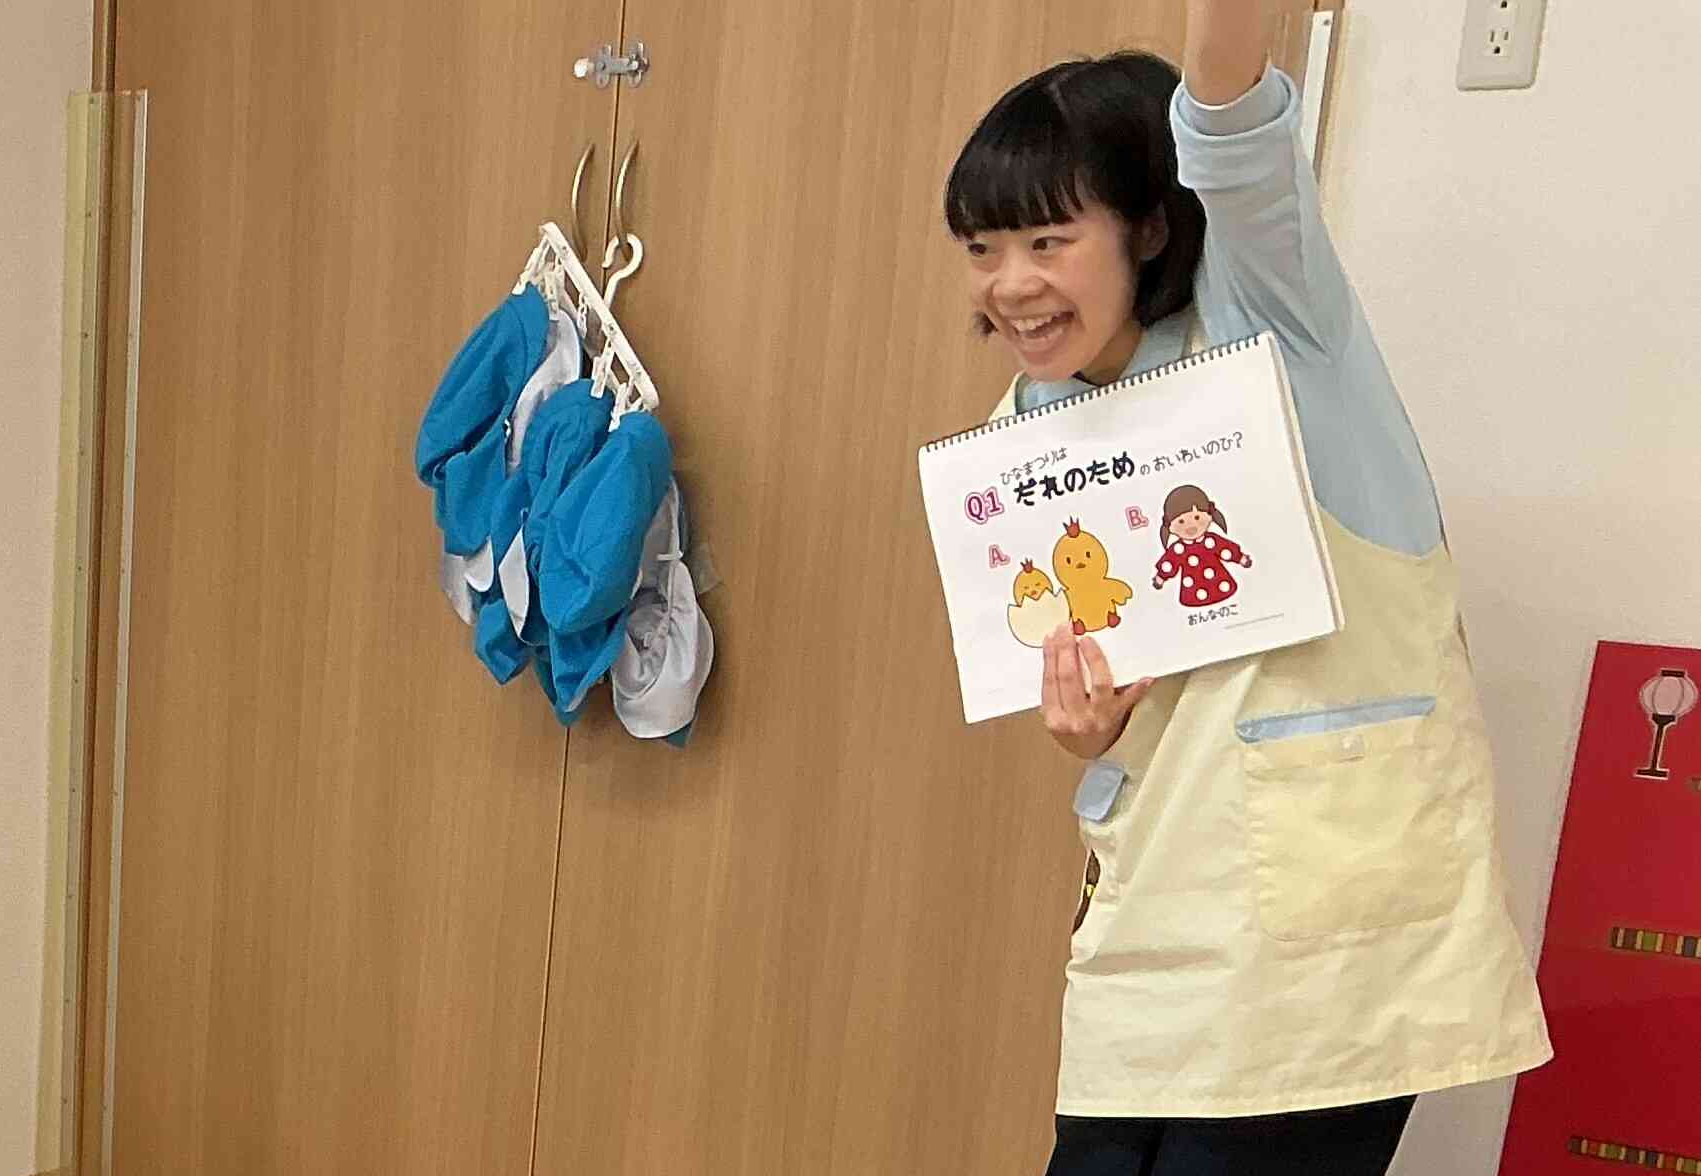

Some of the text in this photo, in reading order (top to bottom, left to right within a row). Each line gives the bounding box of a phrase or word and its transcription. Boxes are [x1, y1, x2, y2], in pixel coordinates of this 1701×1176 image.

[1000, 447, 1068, 485] ひなまつりは
[966, 488, 1003, 523] Q1
